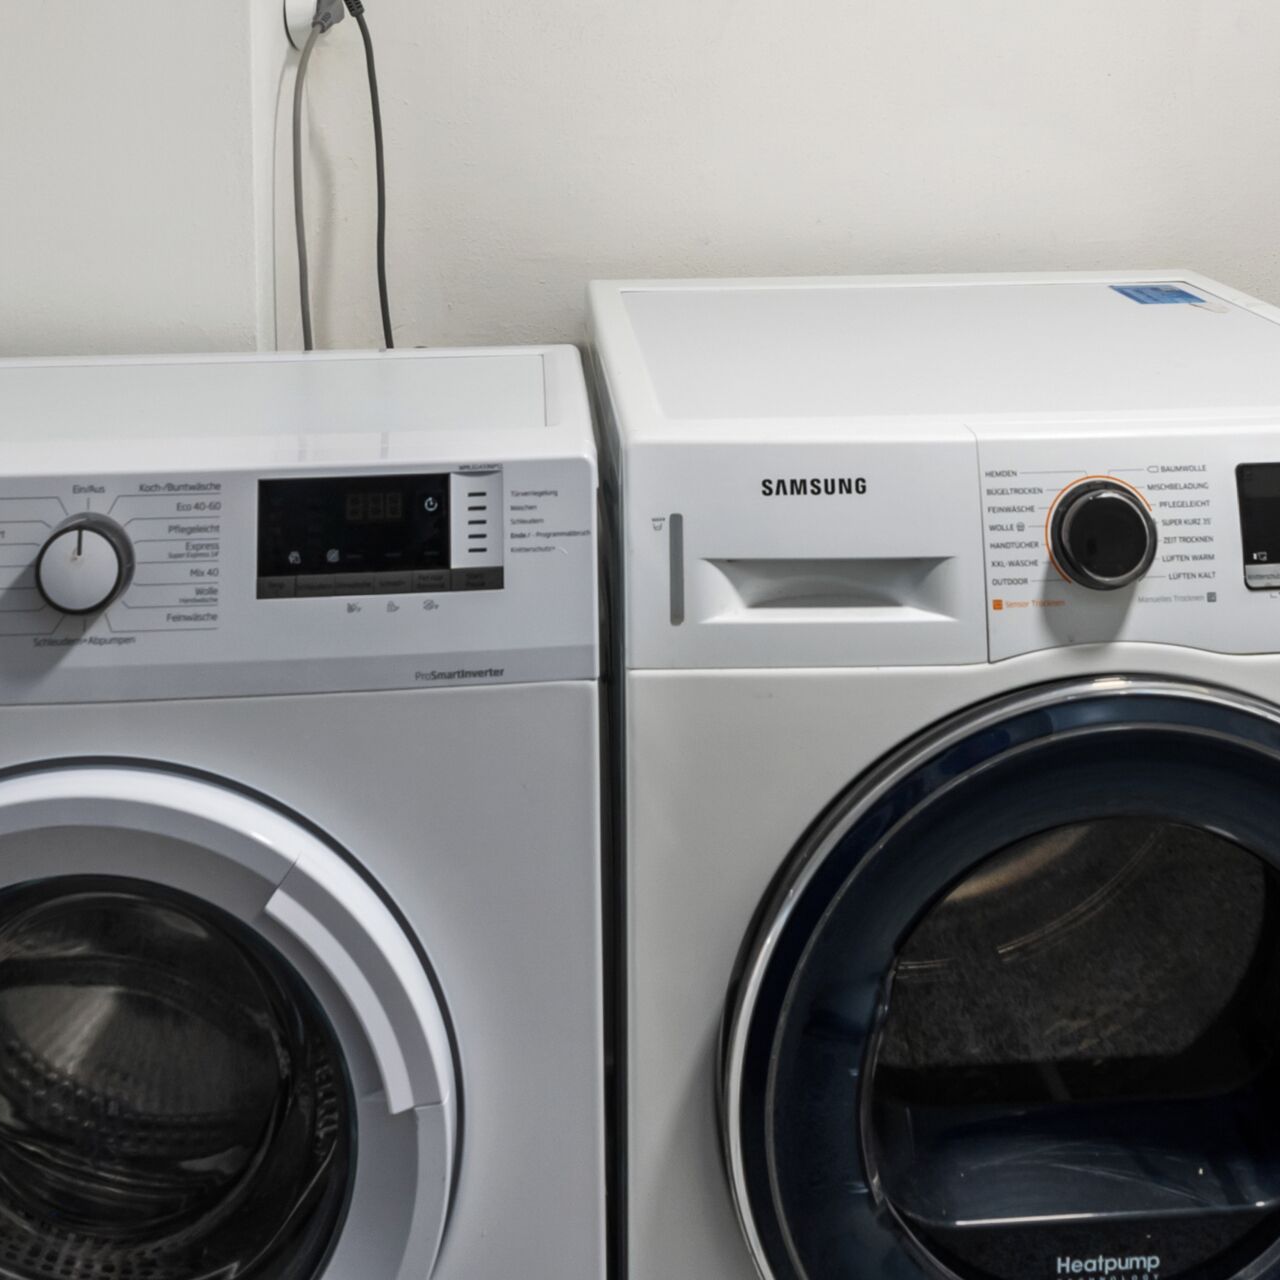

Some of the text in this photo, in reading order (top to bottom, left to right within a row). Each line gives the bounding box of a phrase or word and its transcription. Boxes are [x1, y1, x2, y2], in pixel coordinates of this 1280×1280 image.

[73, 484, 105, 494] Ein/Aus
[139, 483, 221, 492] Koch-/Buntwäsche
[761, 477, 867, 496] SAMSUNG
[1147, 482, 1209, 490] MISCHBELADUNG
[986, 487, 1043, 495] BÜGELTROCKEN
[176, 502, 221, 511] Eco 40-60
[1159, 500, 1210, 508] PFLEGELEICHT
[987, 505, 1035, 513] FEINWÄSCHE
[168, 525, 220, 536] Pflegeleicht
[989, 524, 1014, 532] WOLLE
[1163, 536, 1177, 544] ZEIT
[185, 542, 220, 552] Express
[990, 541, 1039, 549] HANDTÜCHER
[190, 568, 219, 577] Mix 40
[992, 577, 1028, 585] OUTDOOR
[195, 587, 219, 596] Wolle
[167, 613, 218, 622] Feinwäsche
[415, 669, 504, 681] ProSmartInverter
[1056, 1254, 1160, 1275] Heatpump
